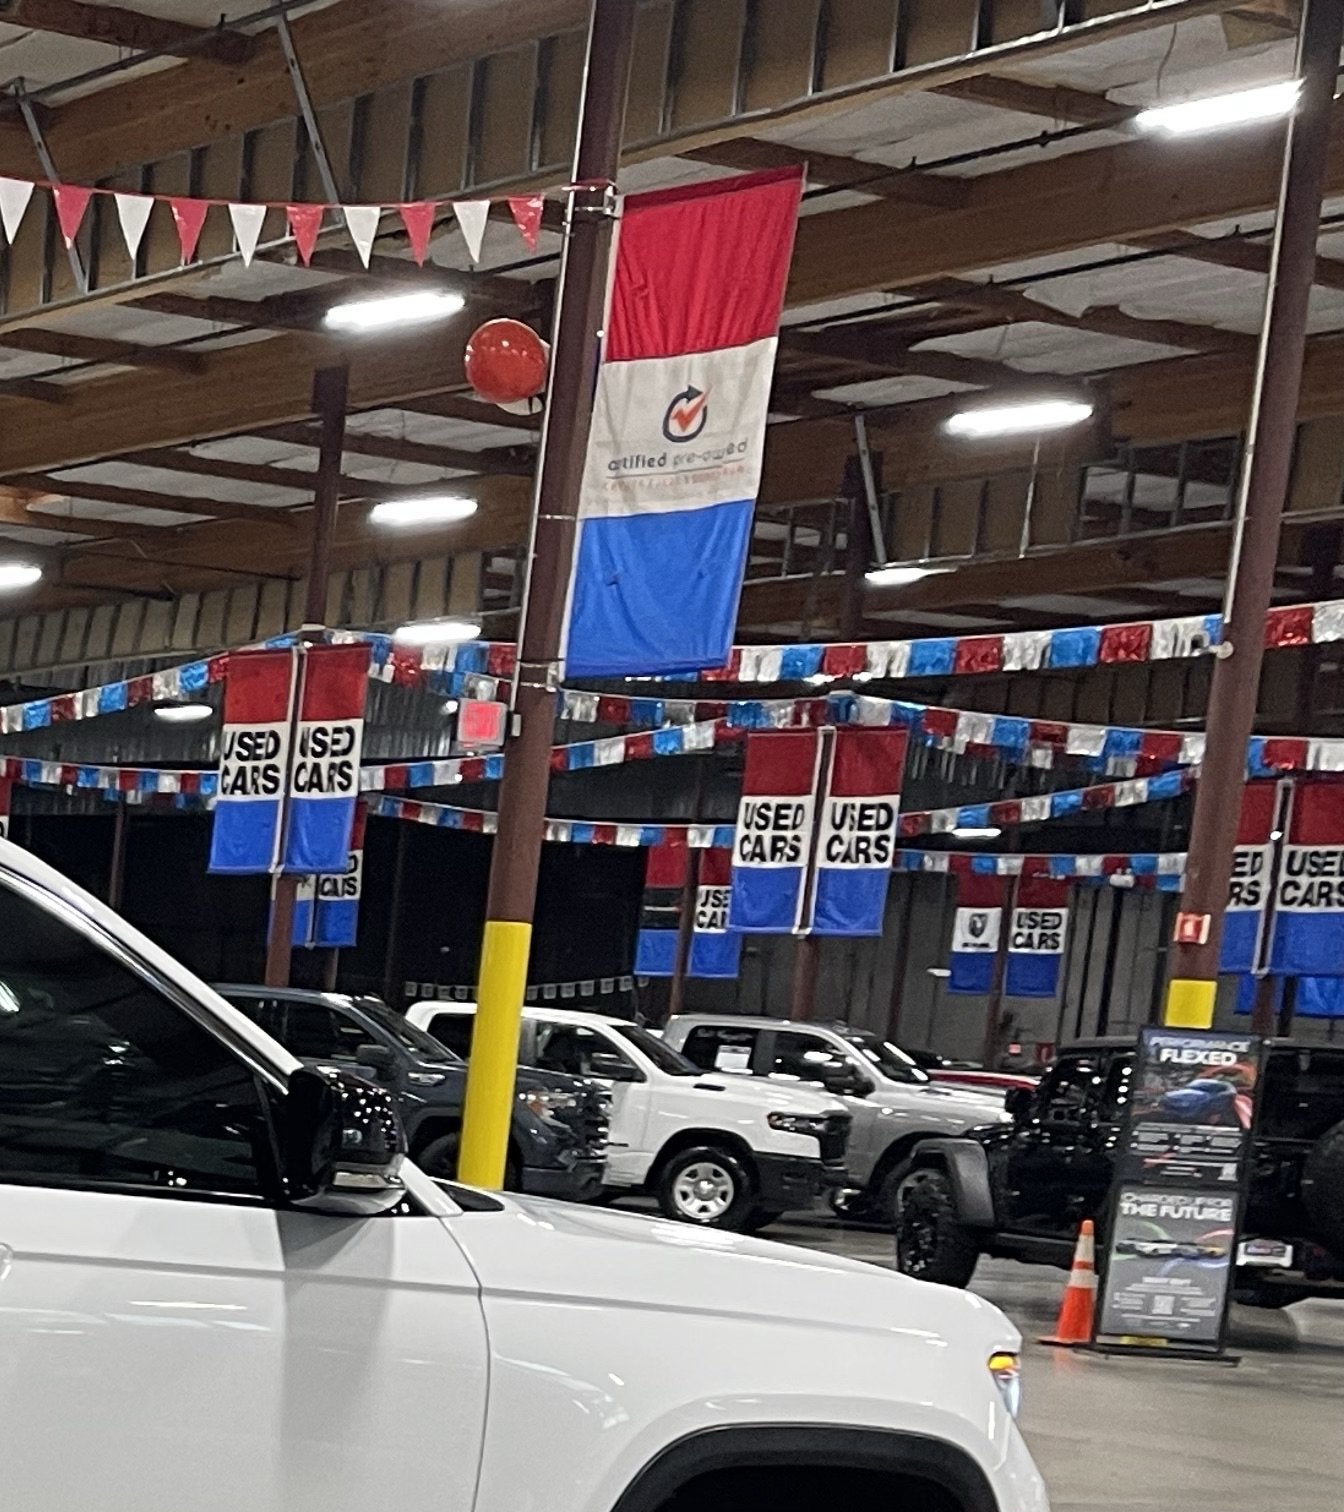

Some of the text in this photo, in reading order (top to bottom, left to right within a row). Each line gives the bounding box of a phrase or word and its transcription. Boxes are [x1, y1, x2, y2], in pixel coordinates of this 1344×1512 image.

[221, 764, 280, 795] CARS
[294, 760, 353, 792] CARS
[744, 803, 804, 831] USED
[740, 835, 801, 863] CARS
[826, 835, 890, 863] CARS
[1232, 852, 1263, 877] ED
[1287, 851, 1344, 877] USE
[1229, 881, 1261, 906] RS
[697, 911, 727, 928] CA
[1120, 1202, 1231, 1221] THE FUTURE
